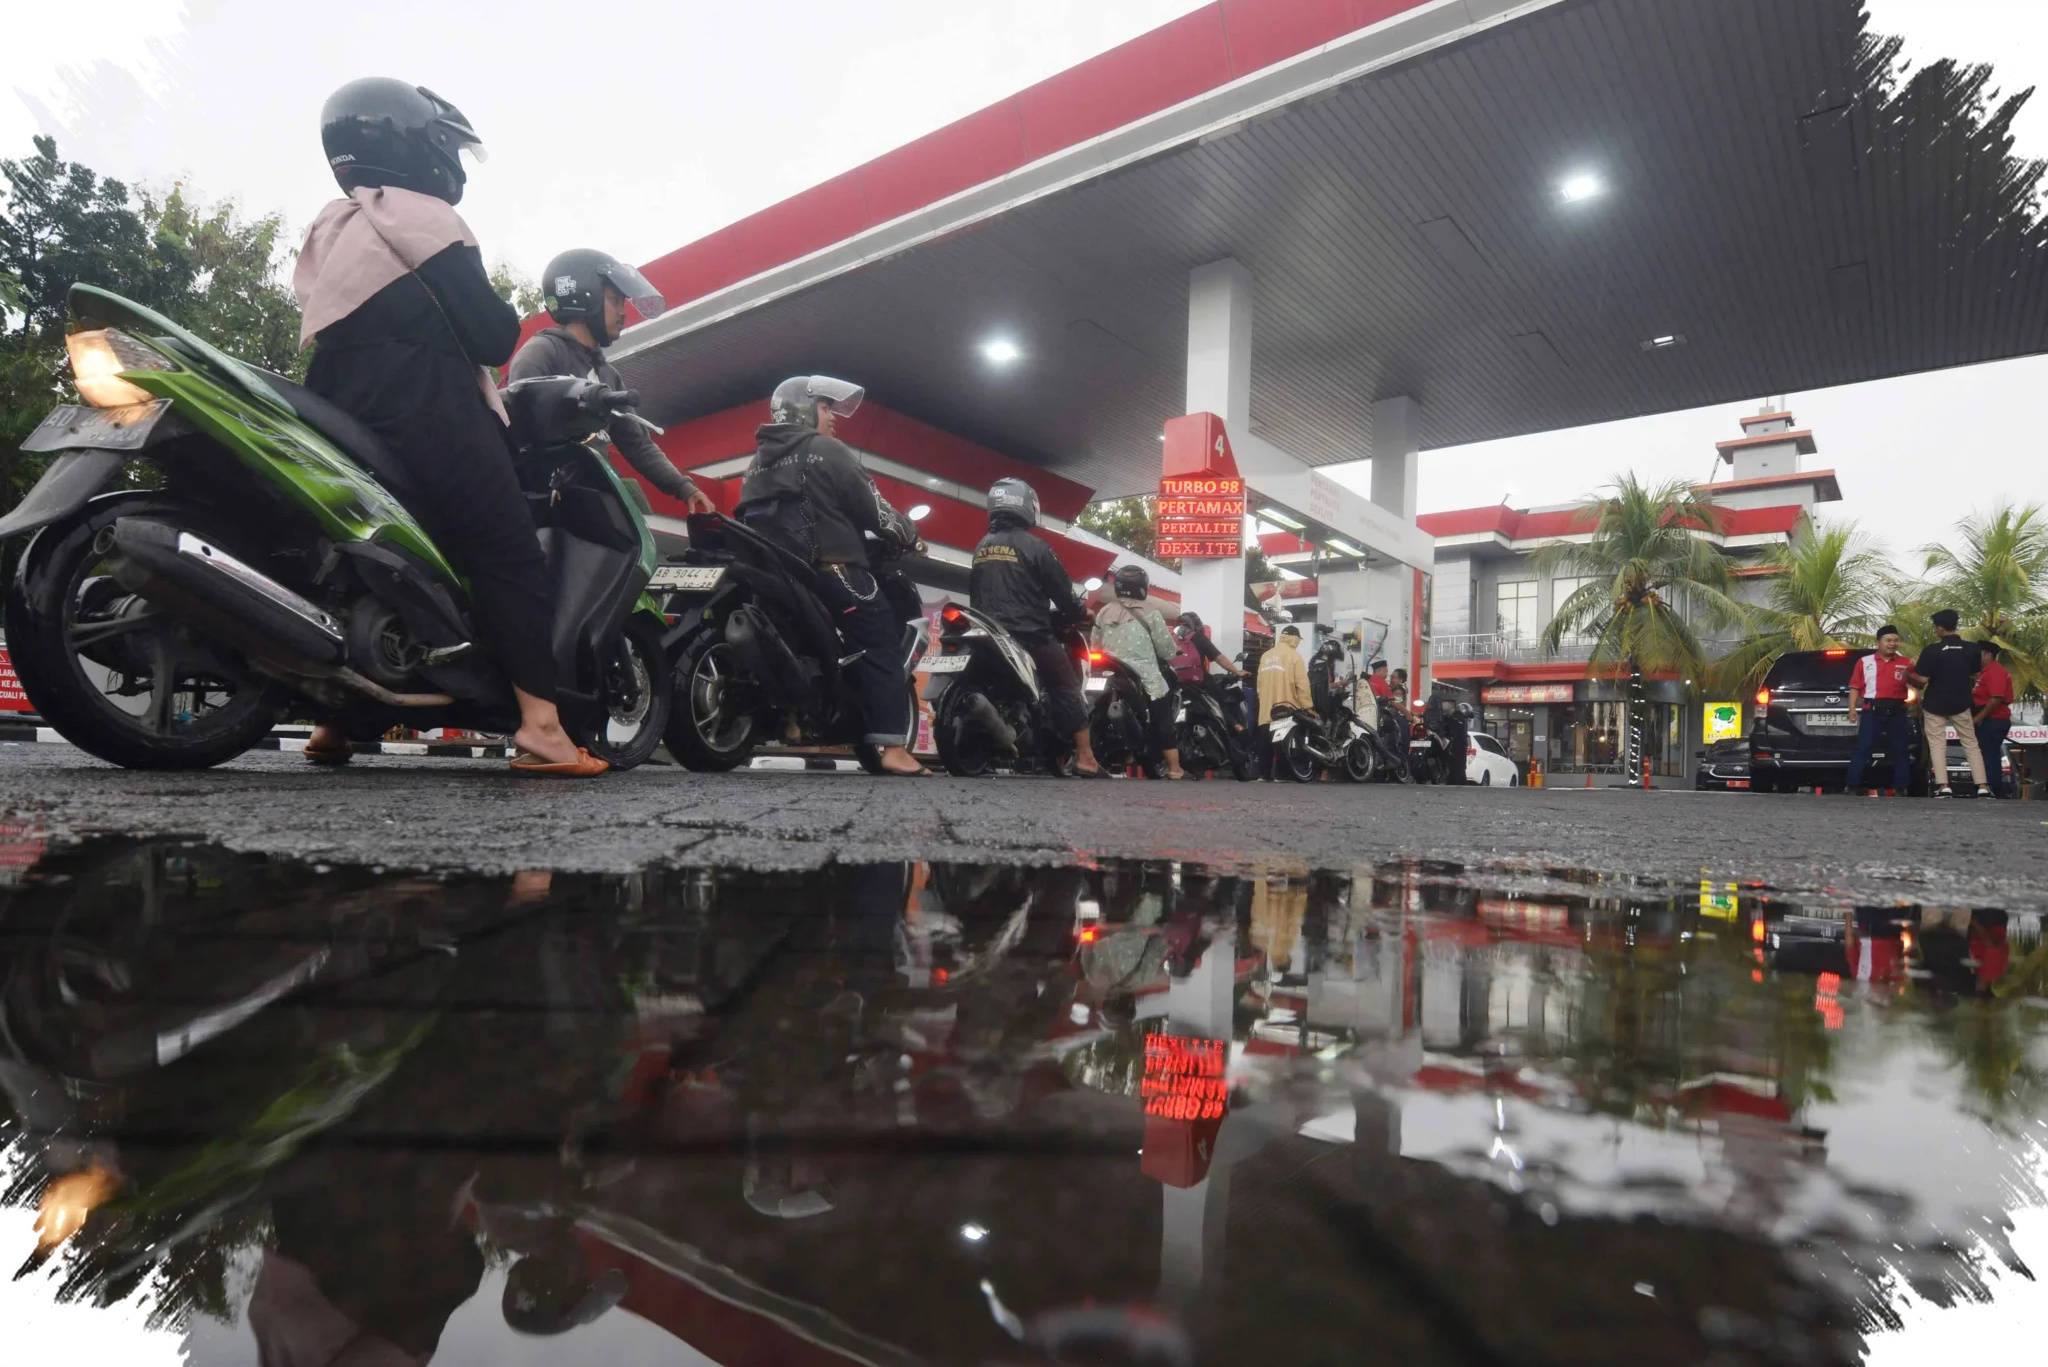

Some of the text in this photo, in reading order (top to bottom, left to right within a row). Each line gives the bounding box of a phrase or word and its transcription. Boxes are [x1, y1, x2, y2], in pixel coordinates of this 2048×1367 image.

[1215, 435, 1225, 457] 4
[1163, 480, 1239, 494] TURBO 98
[1158, 501, 1242, 514] PERTAMAX
[1161, 523, 1238, 533] PERTALITE
[1160, 542, 1237, 554] DEXLITE
[656, 569, 670, 578] AB
[1, 680, 10, 688] KE
